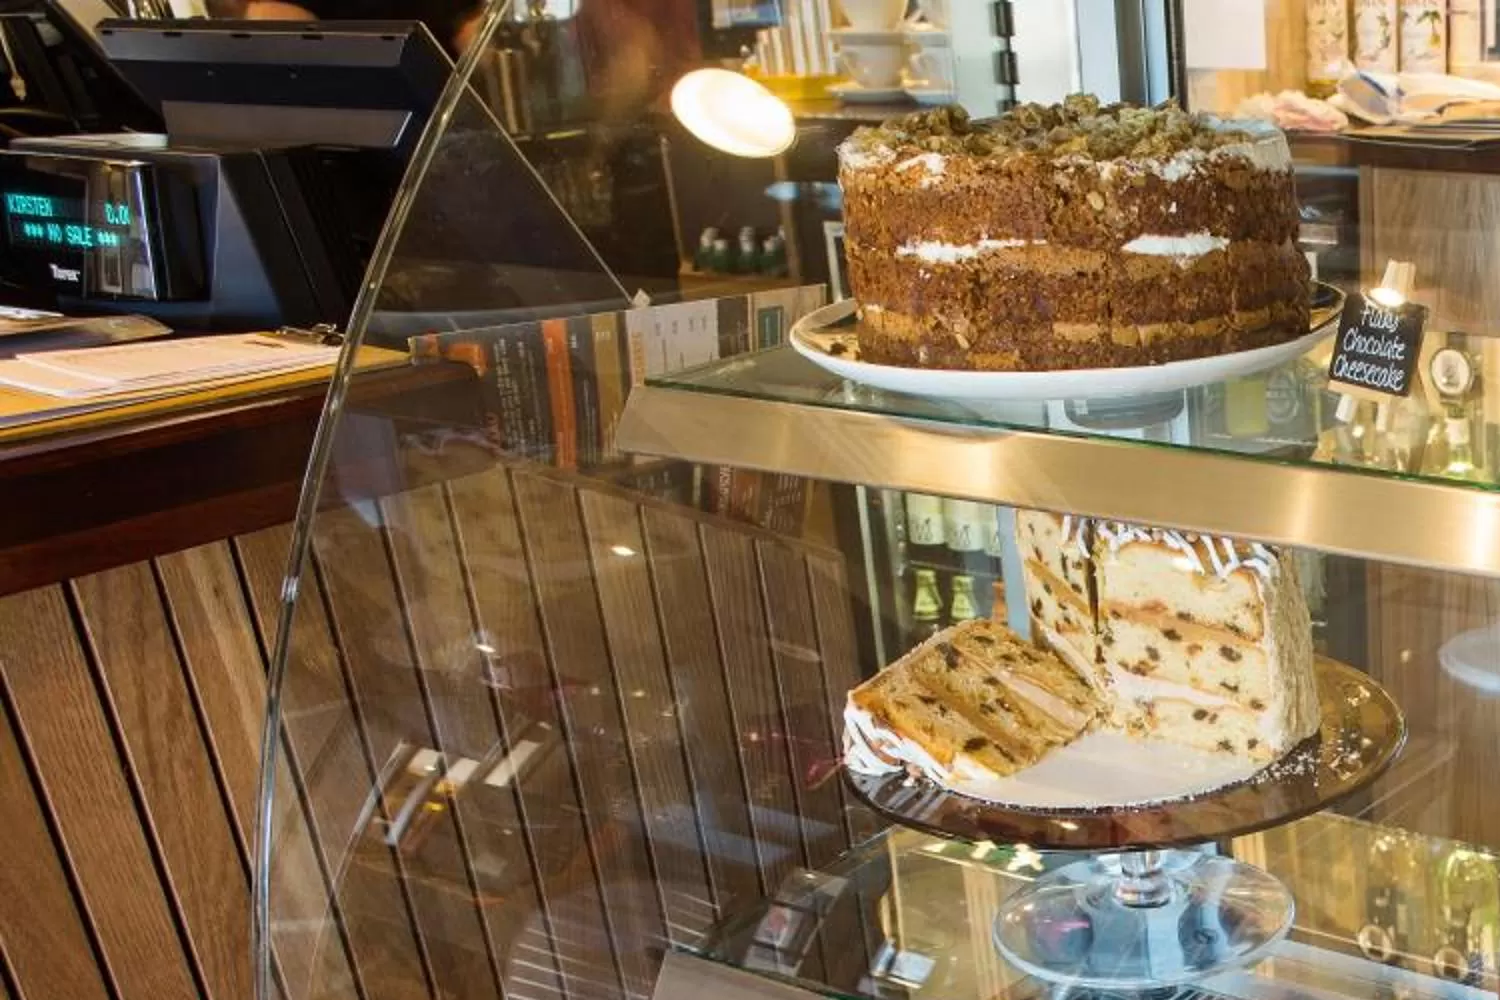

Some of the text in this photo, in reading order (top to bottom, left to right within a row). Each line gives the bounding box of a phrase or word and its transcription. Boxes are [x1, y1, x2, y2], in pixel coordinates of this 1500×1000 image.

[7, 193, 53, 217] KIRSTEN
[64, 223, 93, 248] SALE
[1343, 326, 1405, 361] Chocolate
[1333, 354, 1405, 392] Cheesecake
